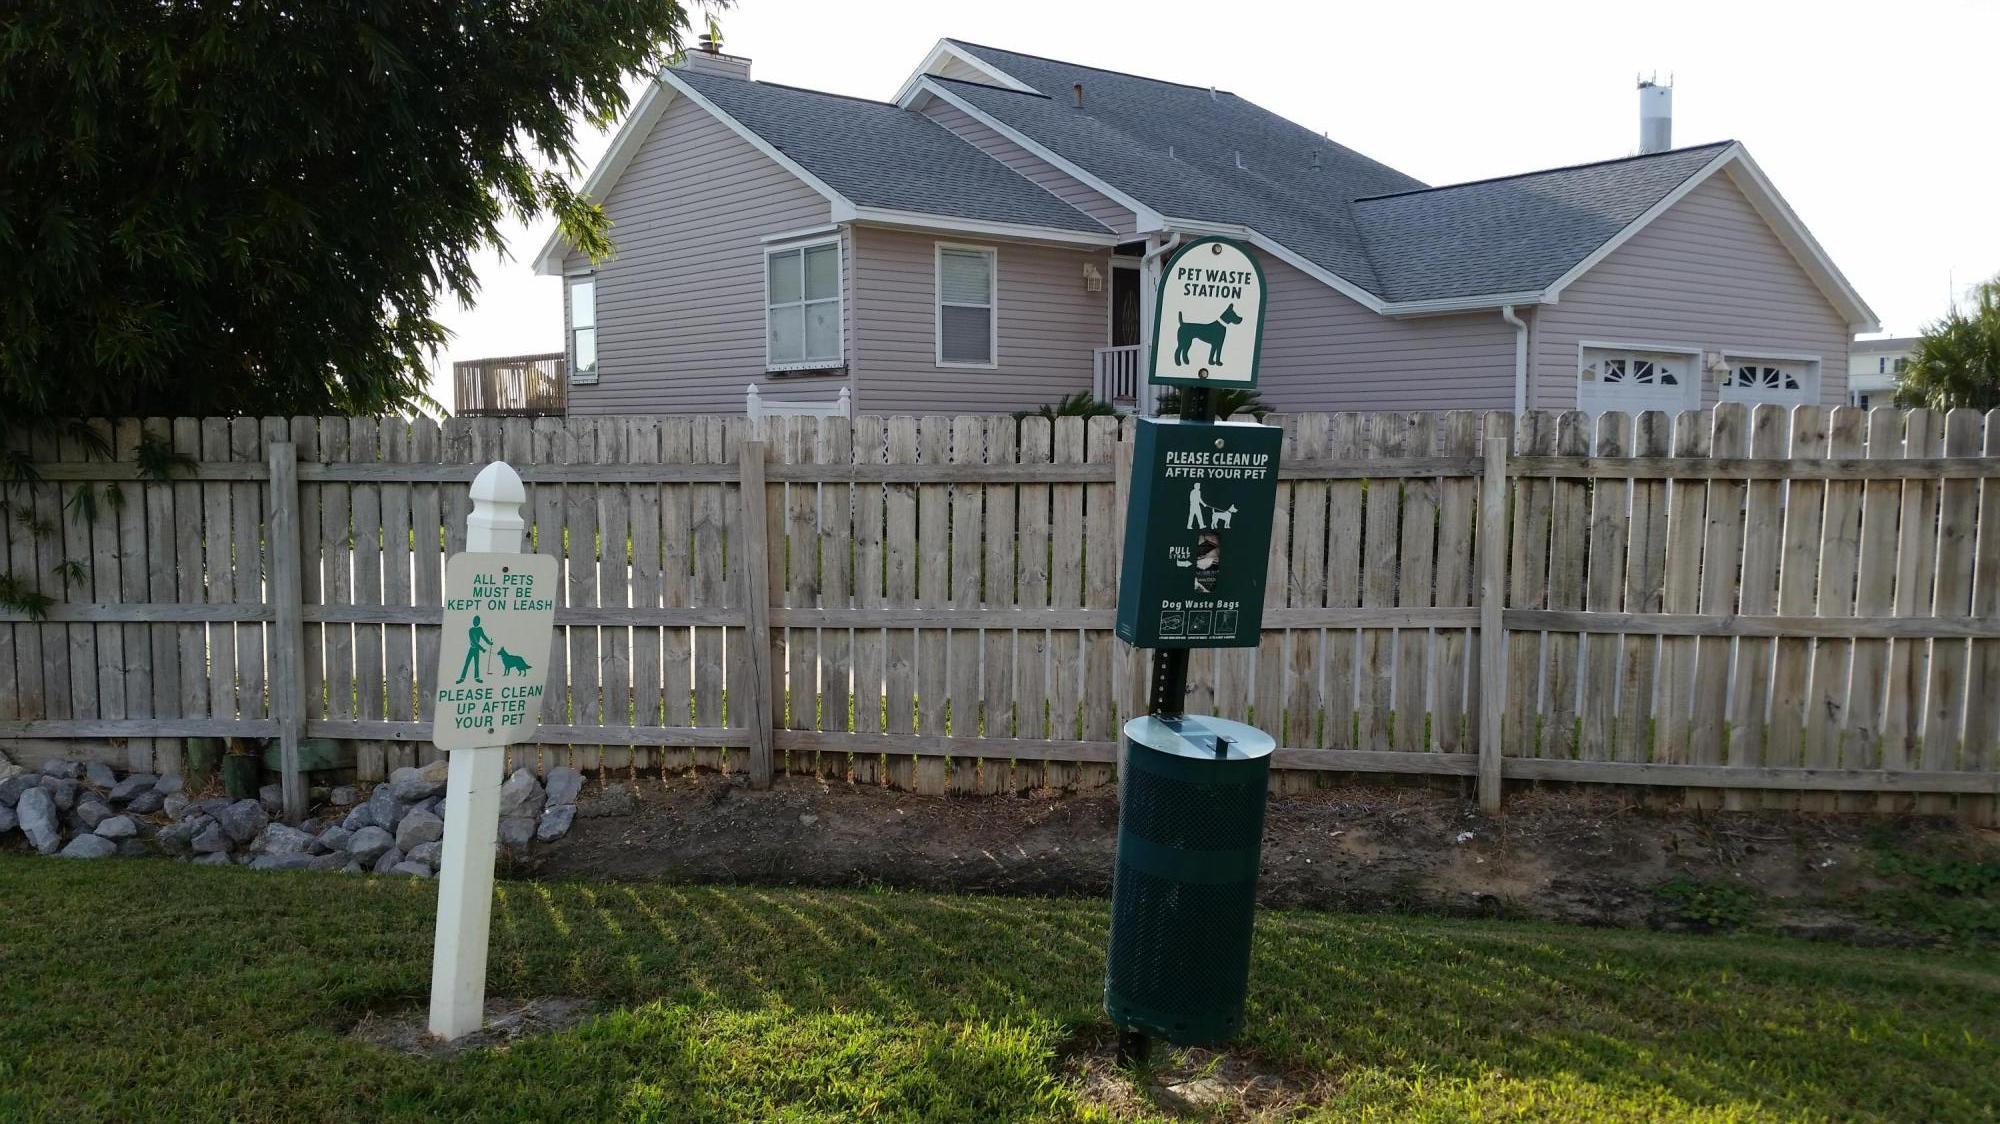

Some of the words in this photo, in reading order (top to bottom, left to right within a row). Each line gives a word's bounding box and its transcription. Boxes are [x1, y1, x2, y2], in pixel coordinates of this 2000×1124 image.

[1178, 267, 1202, 281] PET
[1206, 269, 1251, 285] WASTE
[1184, 283, 1242, 299] STATION
[1166, 451, 1209, 465] PLEASE
[1212, 452, 1250, 466] CLEAN
[1253, 453, 1269, 466] UP
[1165, 467, 1204, 478] AFTER
[1208, 468, 1241, 479] YOUR
[1244, 469, 1267, 480] PET
[1169, 546, 1190, 555] PULL
[473, 574, 496, 585] ALL
[503, 574, 534, 586] PETS
[473, 587, 509, 598] MUST
[516, 587, 532, 598] BE
[447, 600, 482, 611] KEPT
[488, 600, 506, 611] ON
[513, 600, 553, 611] LEASH
[1162, 600, 1182, 610] Dog
[1185, 600, 1214, 609] Waste
[1217, 600, 1240, 610] Bags
[438, 688, 493, 702] PLEASE
[501, 685, 543, 699] CLEAN
[457, 702, 476, 715] UP
[482, 700, 526, 714] AFTER
[455, 715, 493, 729] YOUR
[501, 713, 526, 726] PET
